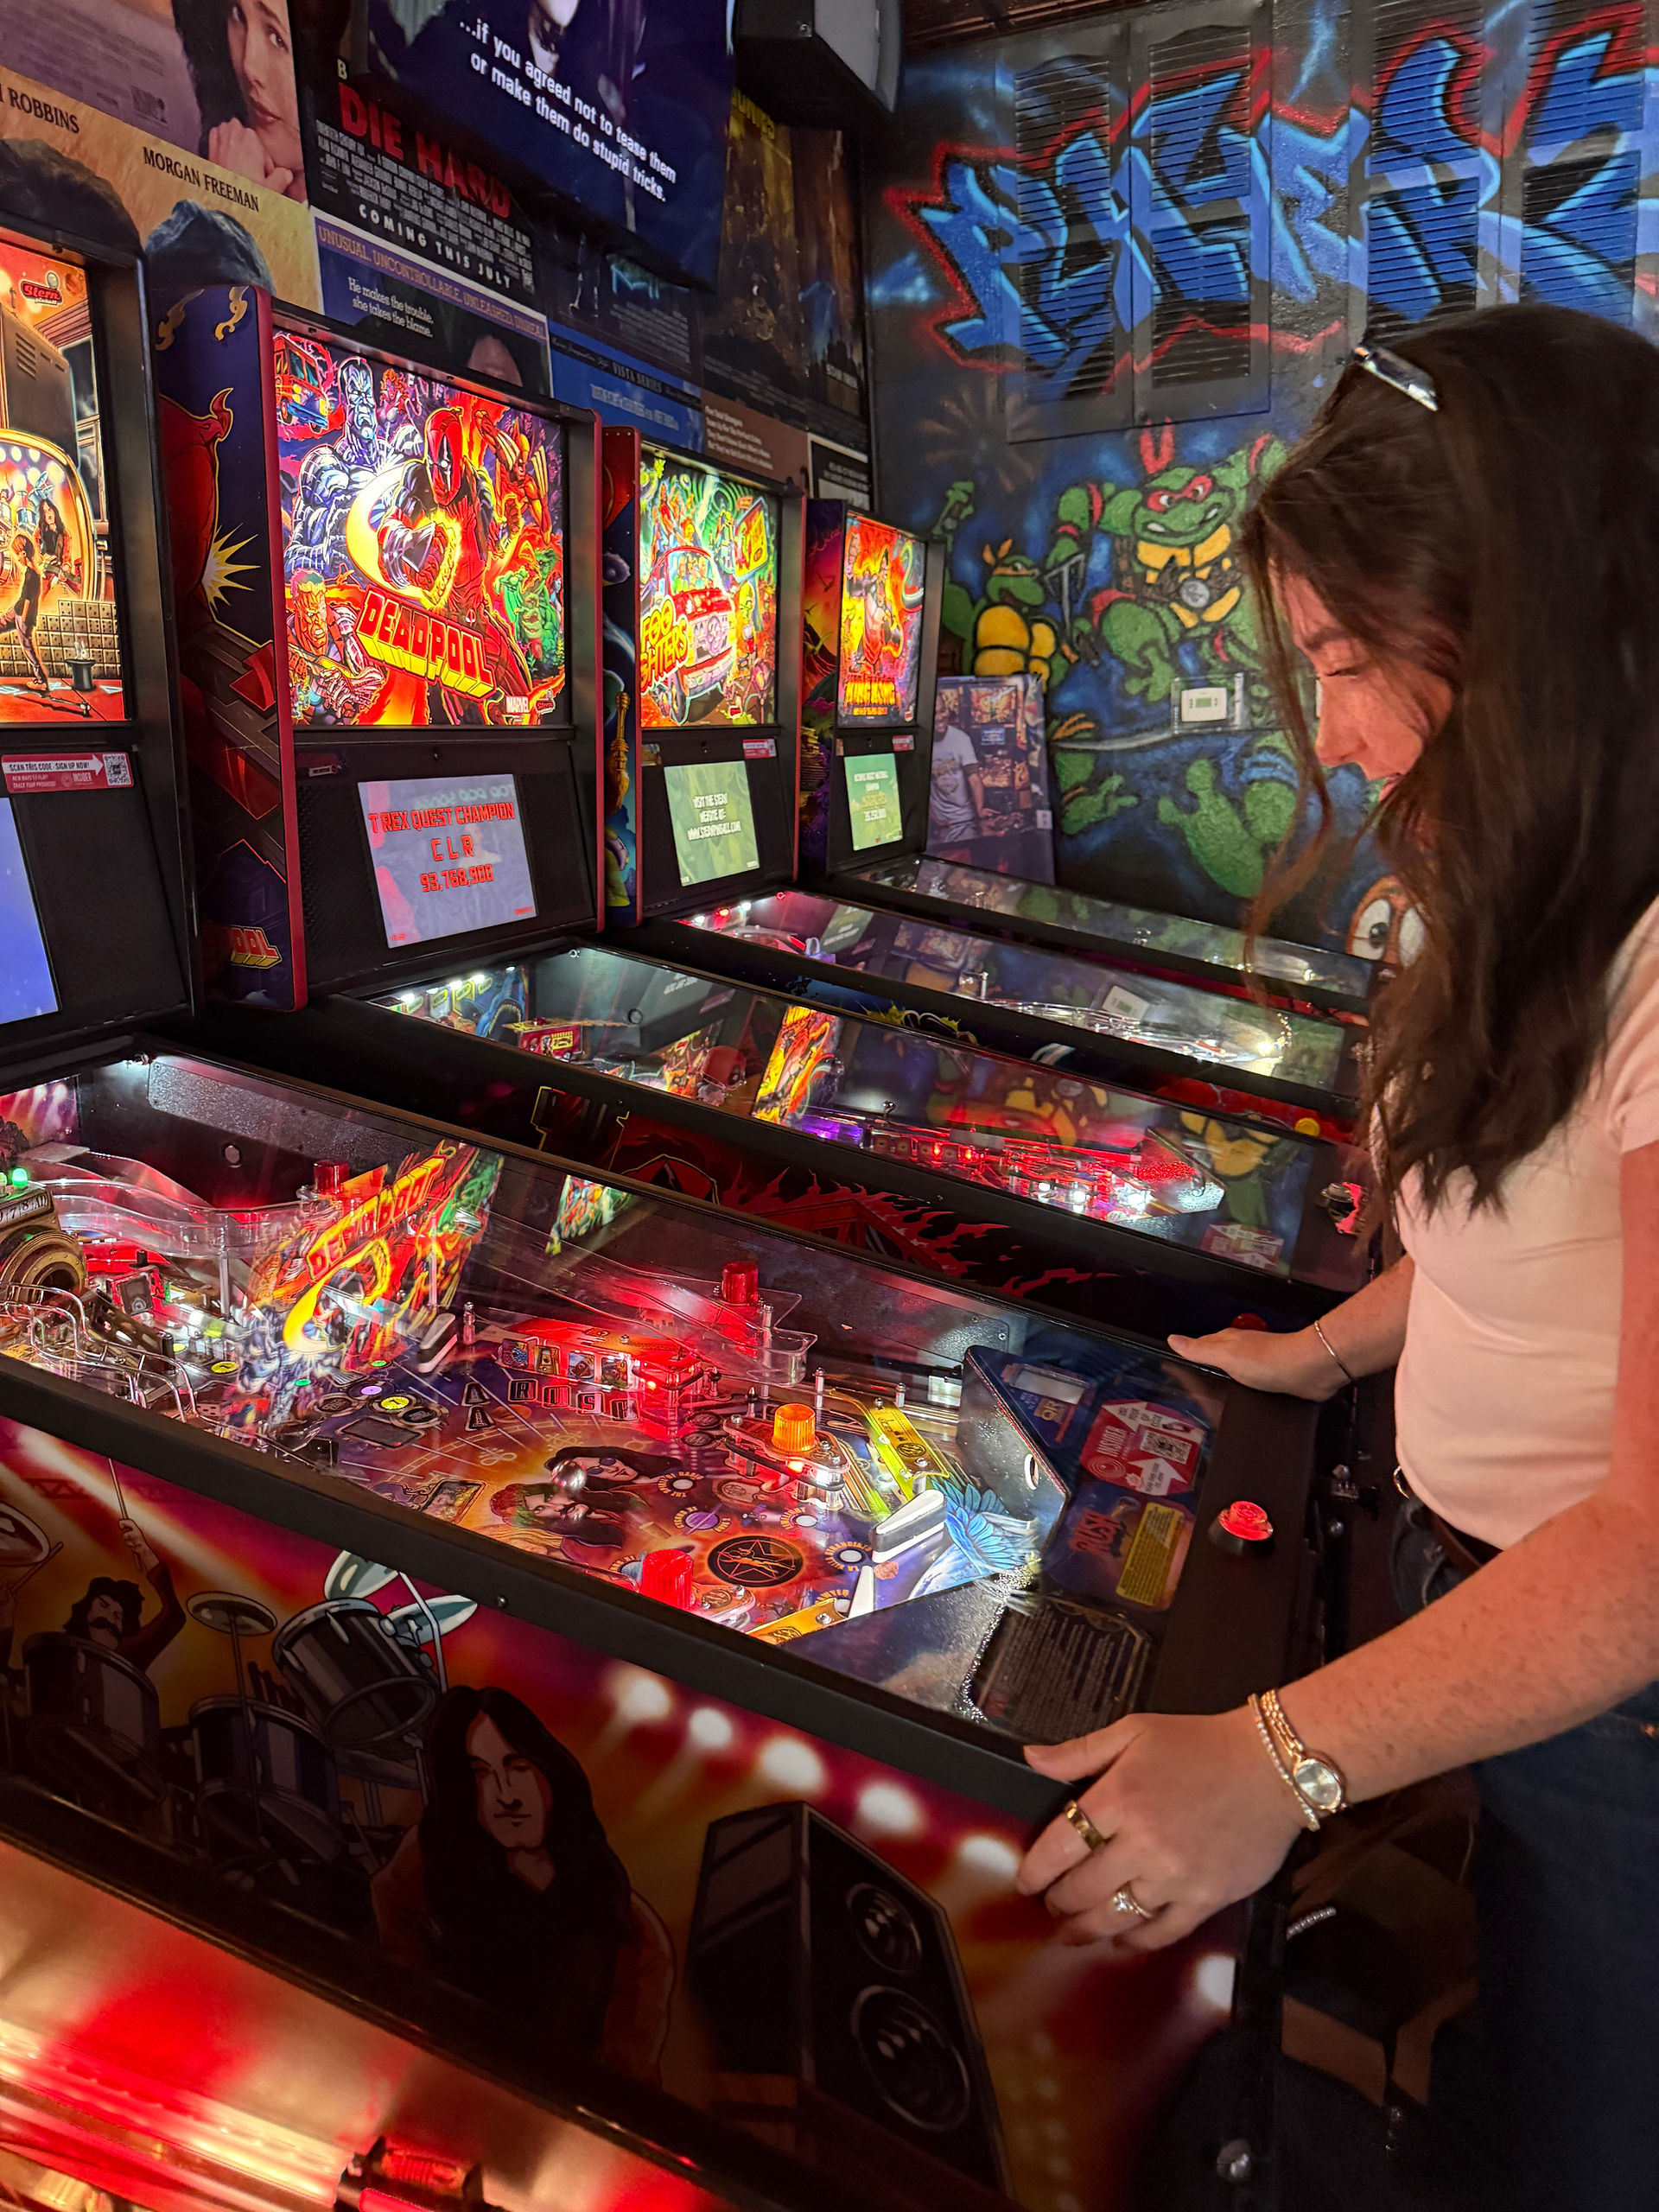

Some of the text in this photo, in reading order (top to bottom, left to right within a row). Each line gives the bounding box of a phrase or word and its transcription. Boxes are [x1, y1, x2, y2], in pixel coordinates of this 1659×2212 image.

[9, 87, 80, 135] ROBBINS
[470, 52, 667, 203] or make them do stupid tricks.
[493, 35, 521, 70] you
[525, 60, 572, 106] agreed
[574, 97, 596, 125] not
[600, 113, 613, 137] to
[616, 126, 646, 162] tease
[649, 150, 677, 184] them
[338, 81, 404, 162] DIE
[416, 131, 512, 219] HARD
[143, 146, 260, 213] MORGAN FREEMAN
[358, 203, 512, 289] COMING THIS JULY
[22, 283, 61, 301] Stern
[347, 276, 361, 292] He
[363, 286, 391, 303] makes
[391, 295, 405, 309] the
[352, 296, 367, 311] she
[369, 303, 391, 322] takes
[392, 312, 405, 327] the
[613, 361, 635, 382] VISTA
[642, 599, 673, 644] FOO
[355, 589, 498, 699] DEADPOOL
[506, 696, 530, 714] MARVEL
[55, 762, 67, 771] SIGN
[368, 802, 515, 834] T REX QUEST CHAMPION
[419, 864, 494, 893] 93,768,900
[1096, 1427, 1125, 1457] INSIDER
[1069, 1509, 1122, 1554] RUSH
